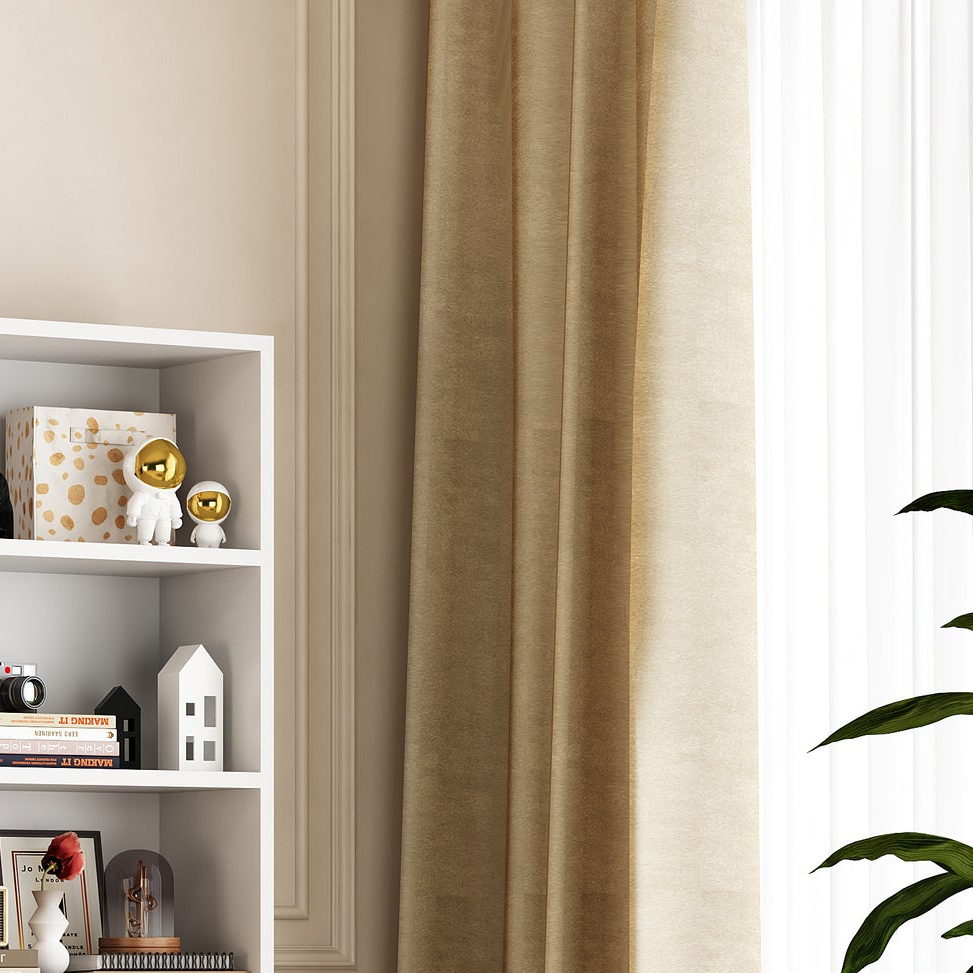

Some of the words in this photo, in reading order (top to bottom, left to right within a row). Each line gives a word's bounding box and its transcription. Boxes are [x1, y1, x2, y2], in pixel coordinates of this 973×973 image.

[71, 717, 109, 725] MAKING
[61, 757, 71, 766] IT
[74, 758, 113, 767] MAKING
